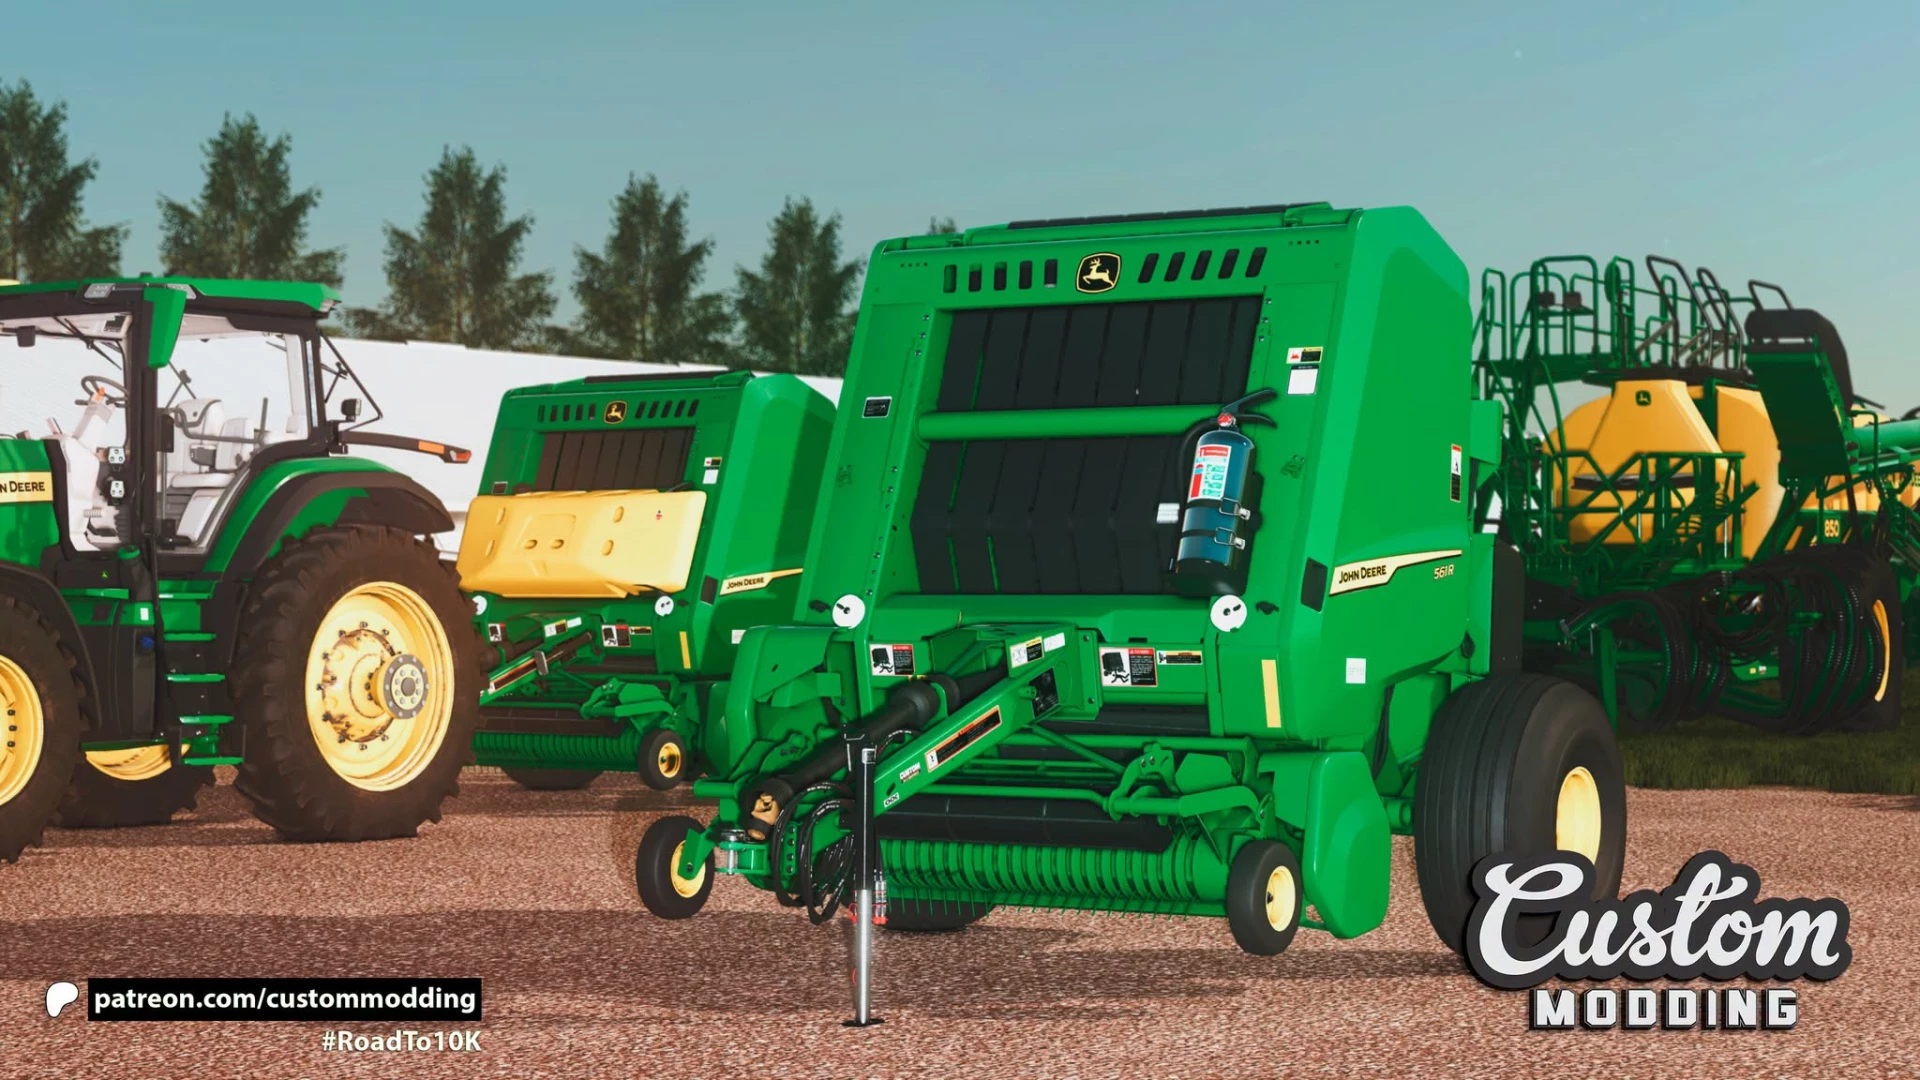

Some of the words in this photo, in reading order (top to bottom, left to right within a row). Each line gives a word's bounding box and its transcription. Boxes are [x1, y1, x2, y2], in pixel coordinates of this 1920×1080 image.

[9, 481, 45, 492] DEERE
[1824, 519, 1839, 537] 850
[1339, 570, 1360, 584] JOHN
[1361, 565, 1387, 579] DEERE
[727, 581, 743, 589] JOHN
[744, 577, 764, 586] DEERE
